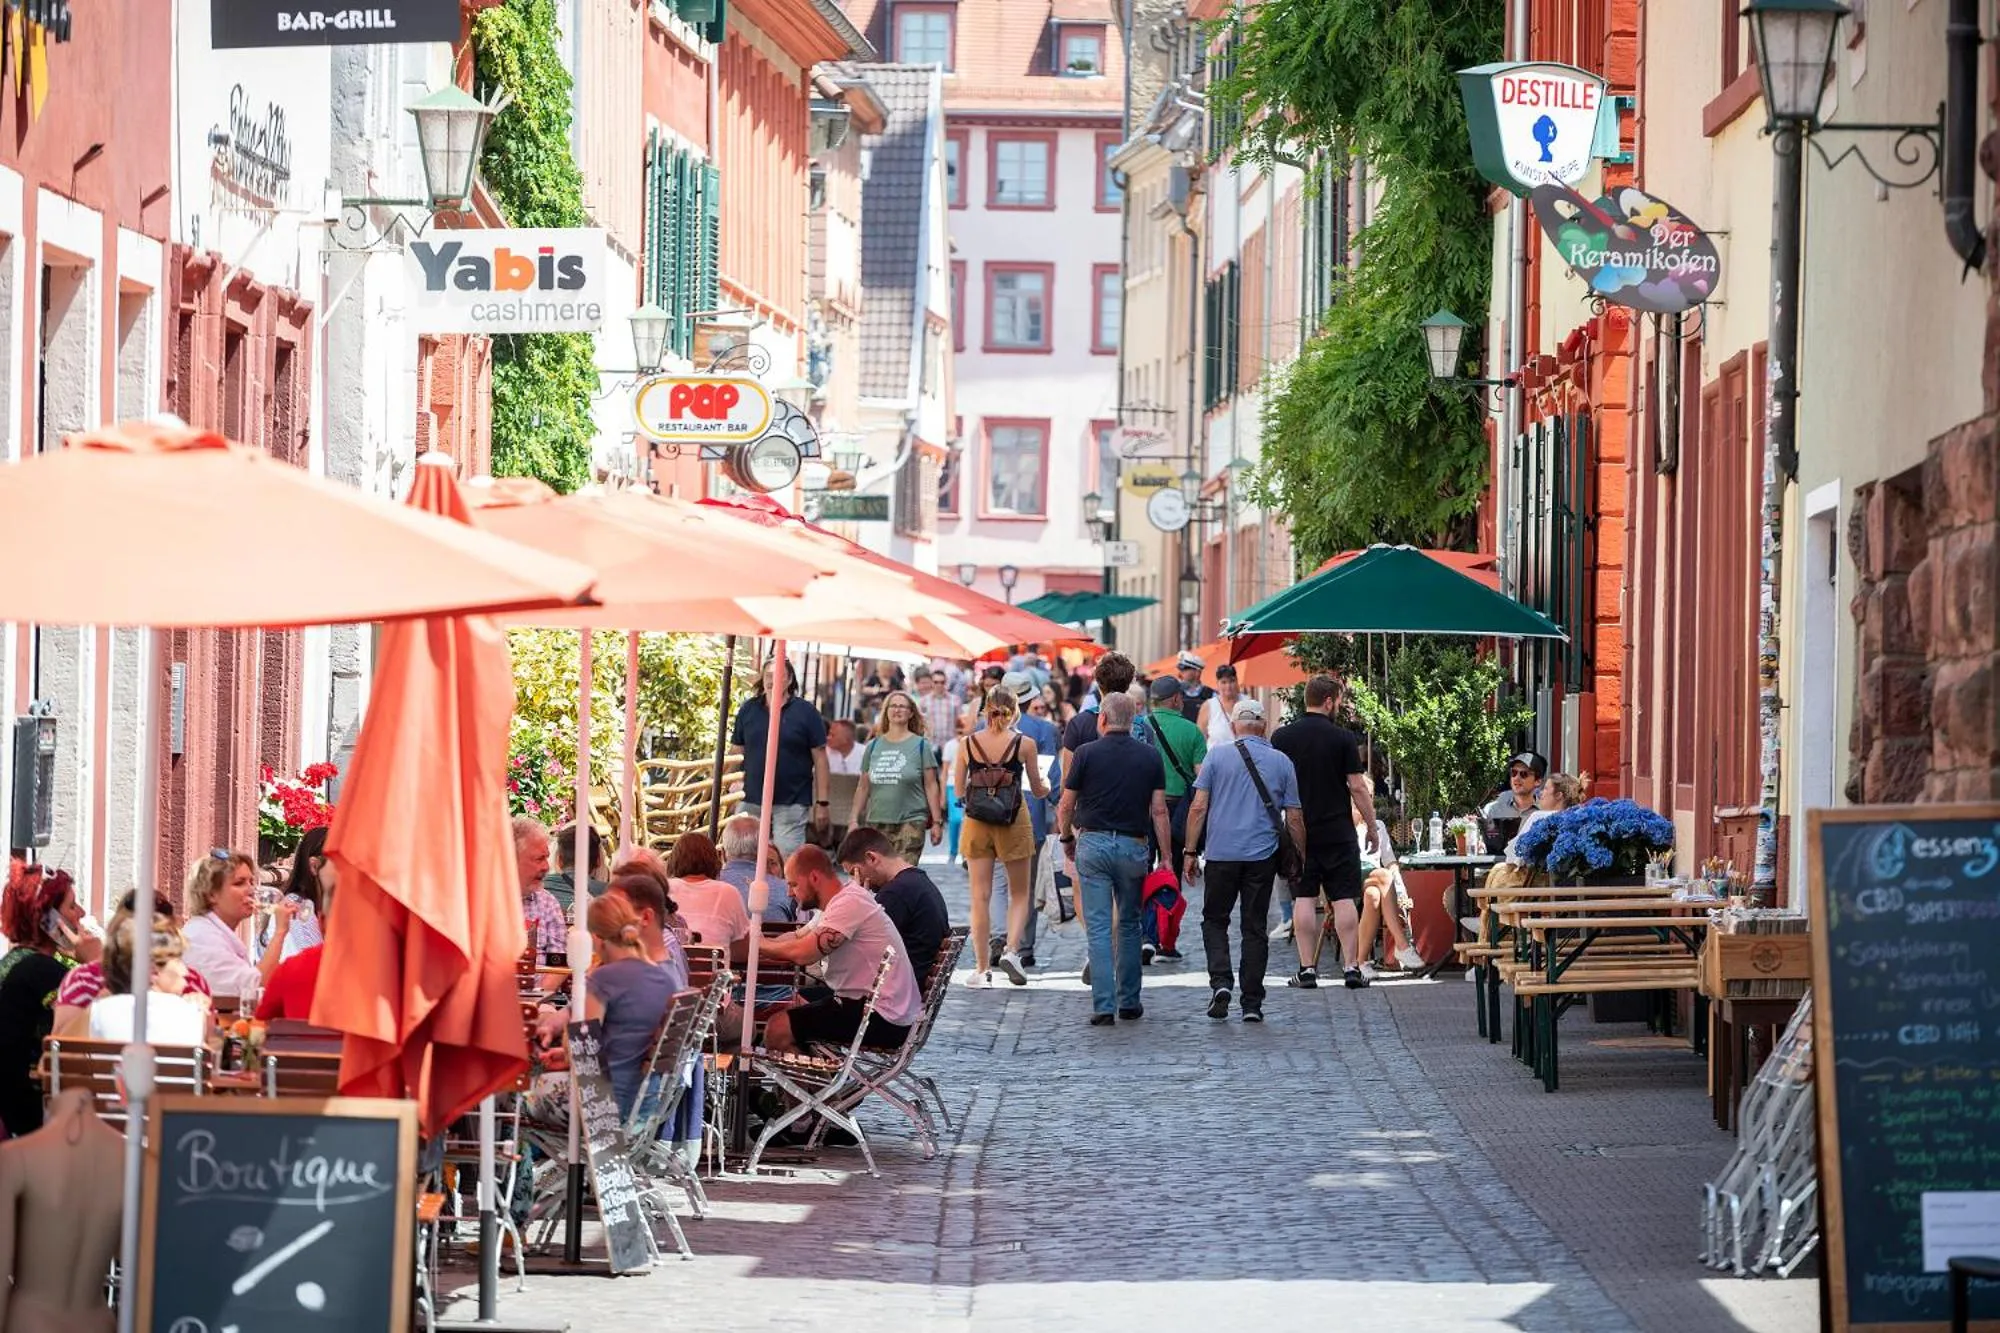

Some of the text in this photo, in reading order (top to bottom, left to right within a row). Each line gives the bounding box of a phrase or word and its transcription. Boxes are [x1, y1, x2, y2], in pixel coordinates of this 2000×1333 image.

[278, 9, 396, 31] BAR-GRILL
[1502, 78, 1594, 110] DESTILLE
[1651, 225, 1697, 248] Der
[409, 241, 586, 292] Yabis
[1570, 243, 1717, 275] Keramikofen
[471, 298, 601, 321] cashmere
[727, 422, 748, 433] BAR
[1856, 886, 1904, 915] CBD
[1897, 1024, 1940, 1045] CBD
[177, 1129, 393, 1213] Boutique
